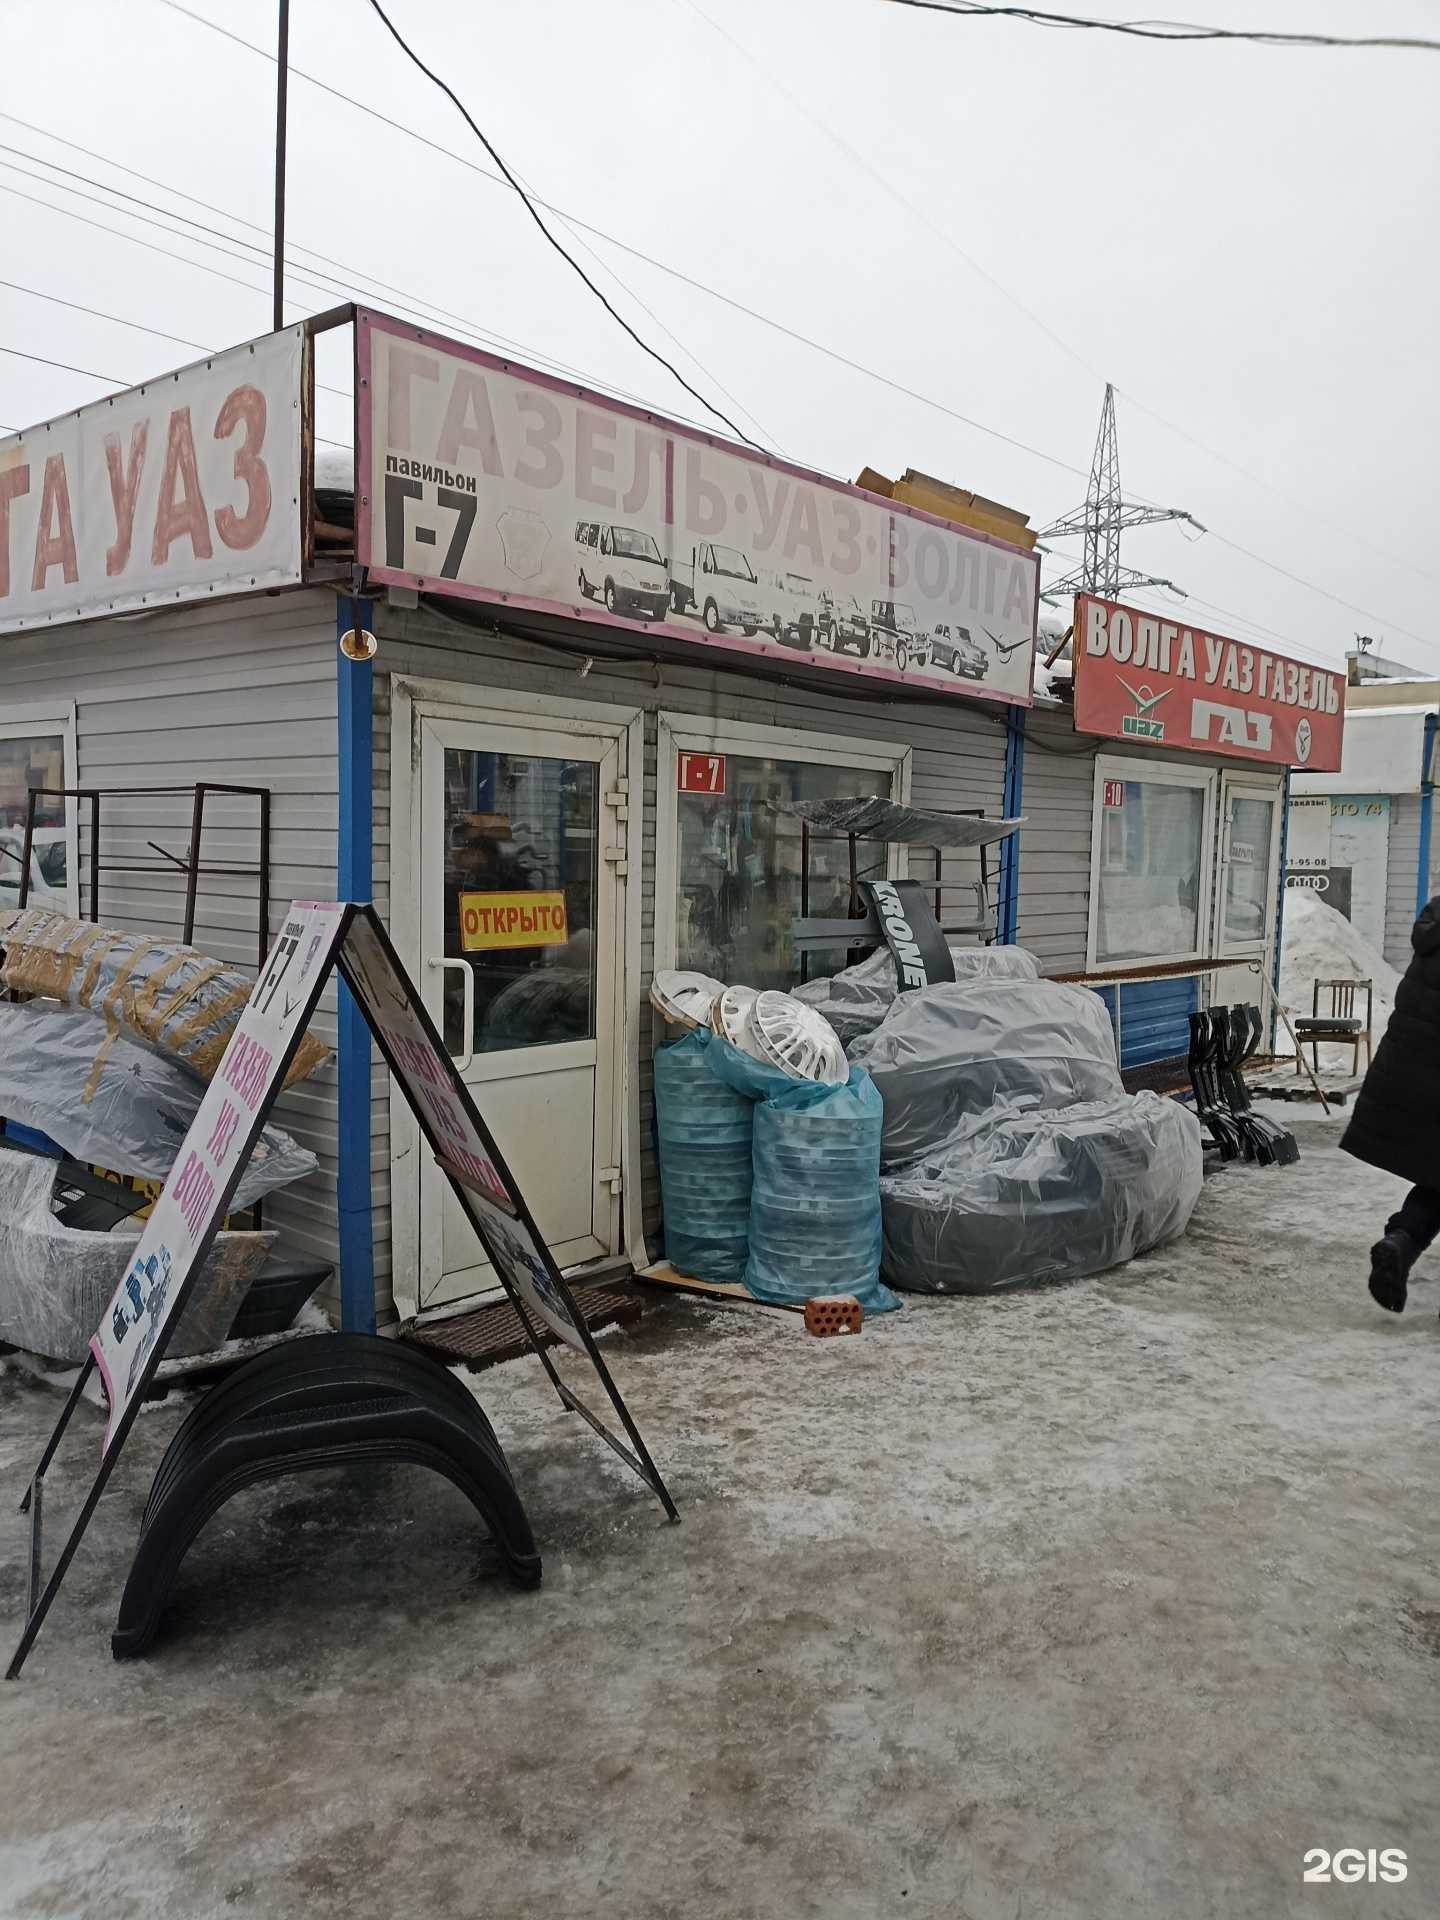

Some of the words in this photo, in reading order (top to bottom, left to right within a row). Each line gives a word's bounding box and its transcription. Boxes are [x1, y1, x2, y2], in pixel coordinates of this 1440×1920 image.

[104, 384, 272, 578] УАЗ
[386, 454, 477, 494] павильон
[385, 474, 477, 580] Г-7
[1086, 600, 1197, 681] ВОЛГА
[1204, 636, 1255, 694] УАЗ
[1258, 654, 1341, 715] ГАЗЕЛЬ
[1190, 698, 1273, 752] ГАЗ
[681, 755, 720, 791] Г-7
[464, 905, 565, 935] ОТКРЫТО
[868, 881, 928, 990] KRONE
[222, 1031, 273, 1112] ГАЗЕЛЬ
[206, 1098, 240, 1168] УАЗ
[172, 1150, 215, 1246] ВОЛГА
